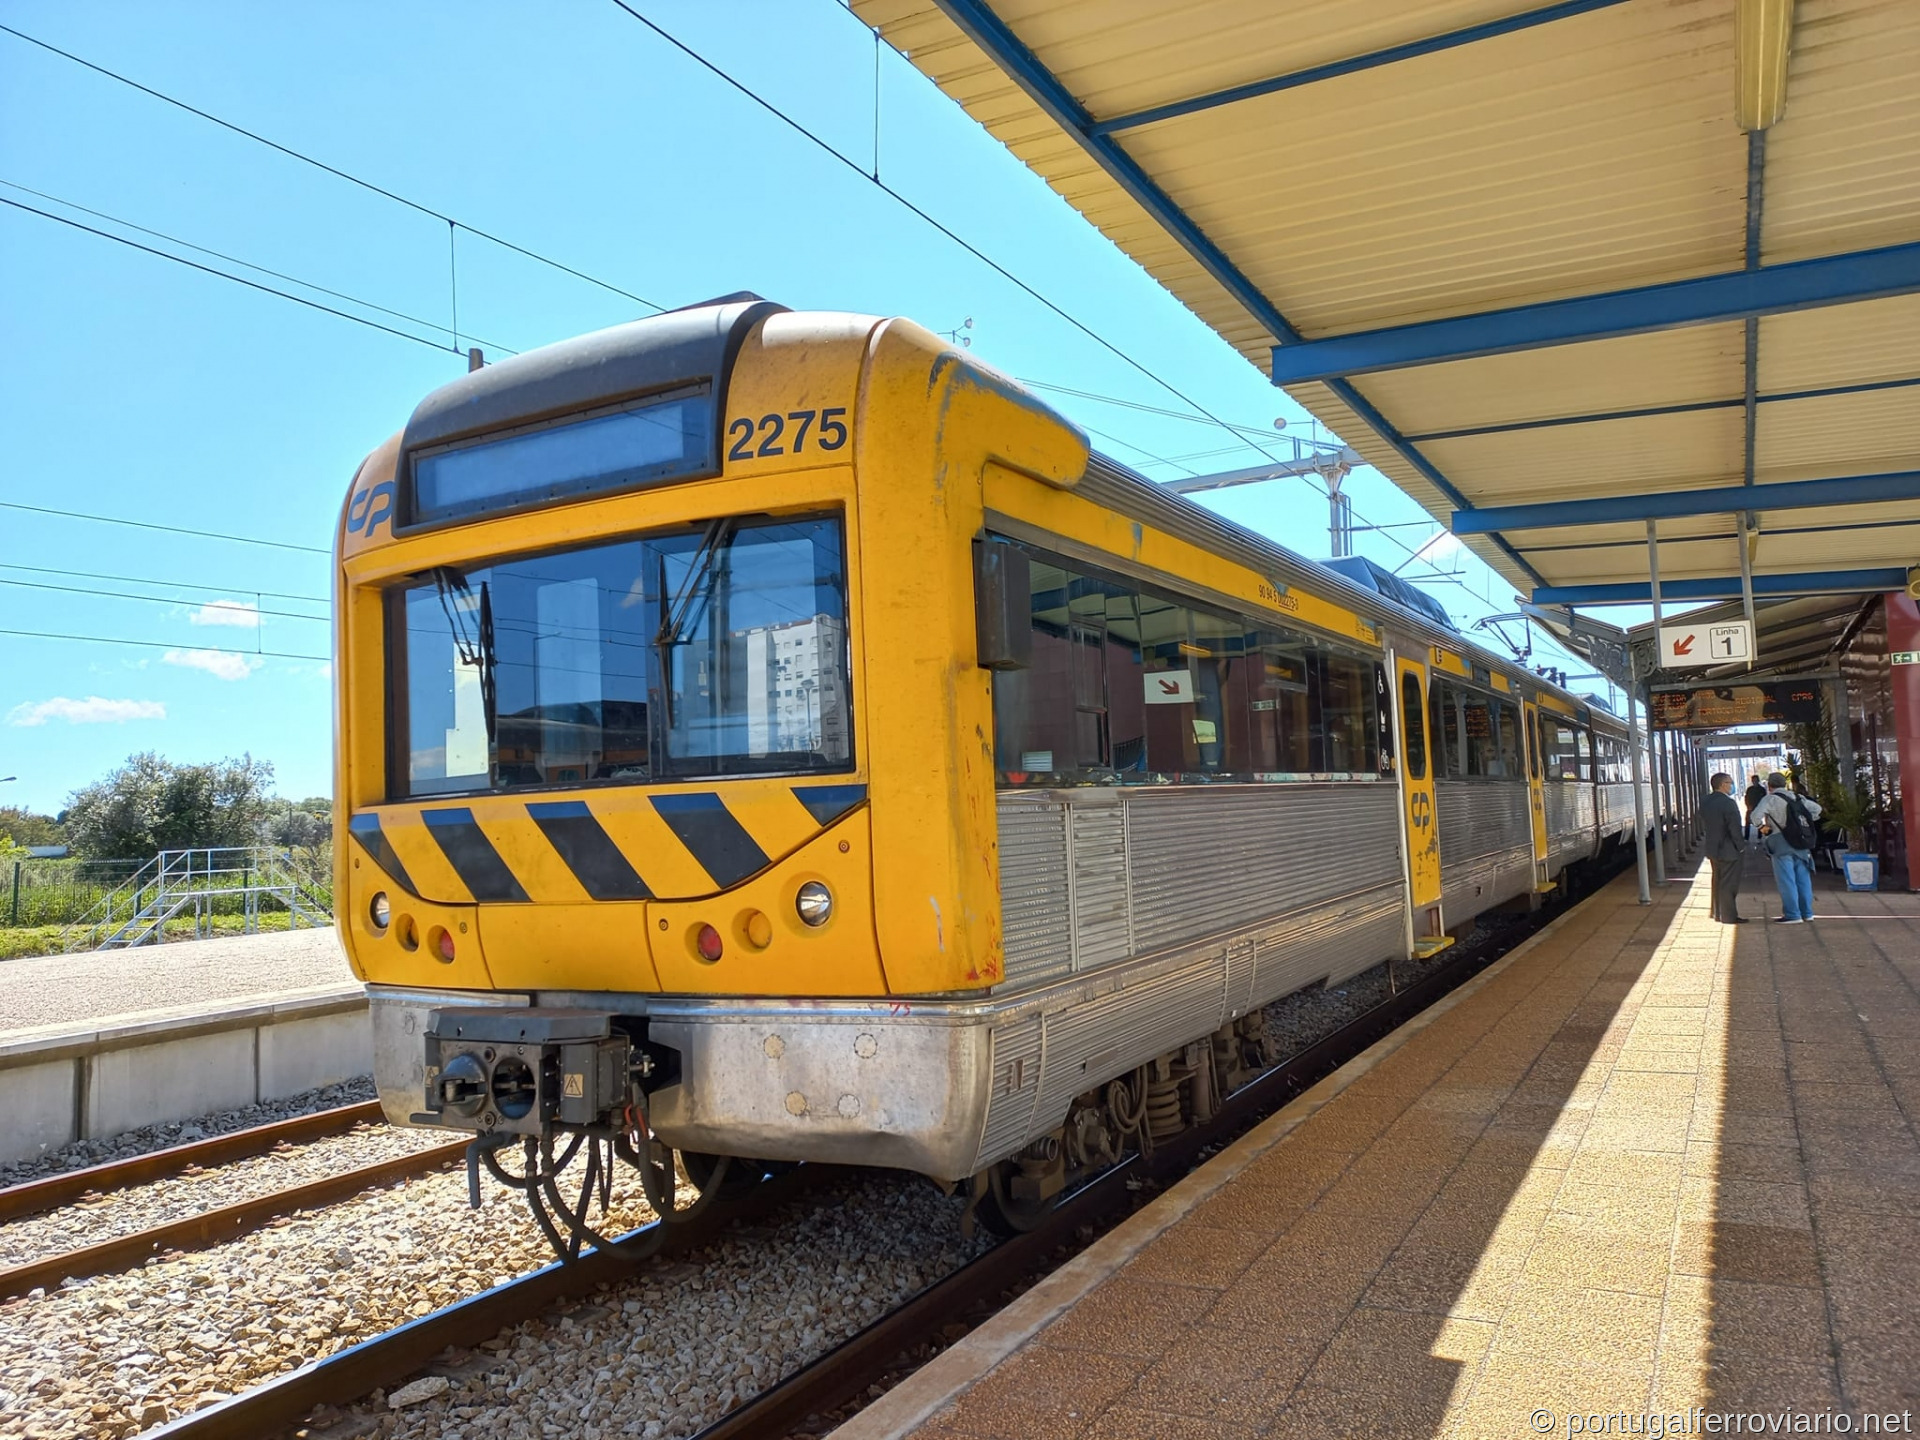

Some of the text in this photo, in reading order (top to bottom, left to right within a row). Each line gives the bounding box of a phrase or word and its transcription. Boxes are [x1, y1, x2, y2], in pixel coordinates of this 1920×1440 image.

[728, 407, 848, 462] 2275
[347, 480, 396, 539] CP
[1715, 628, 1739, 637] Linha
[1721, 636, 1732, 655] 1
